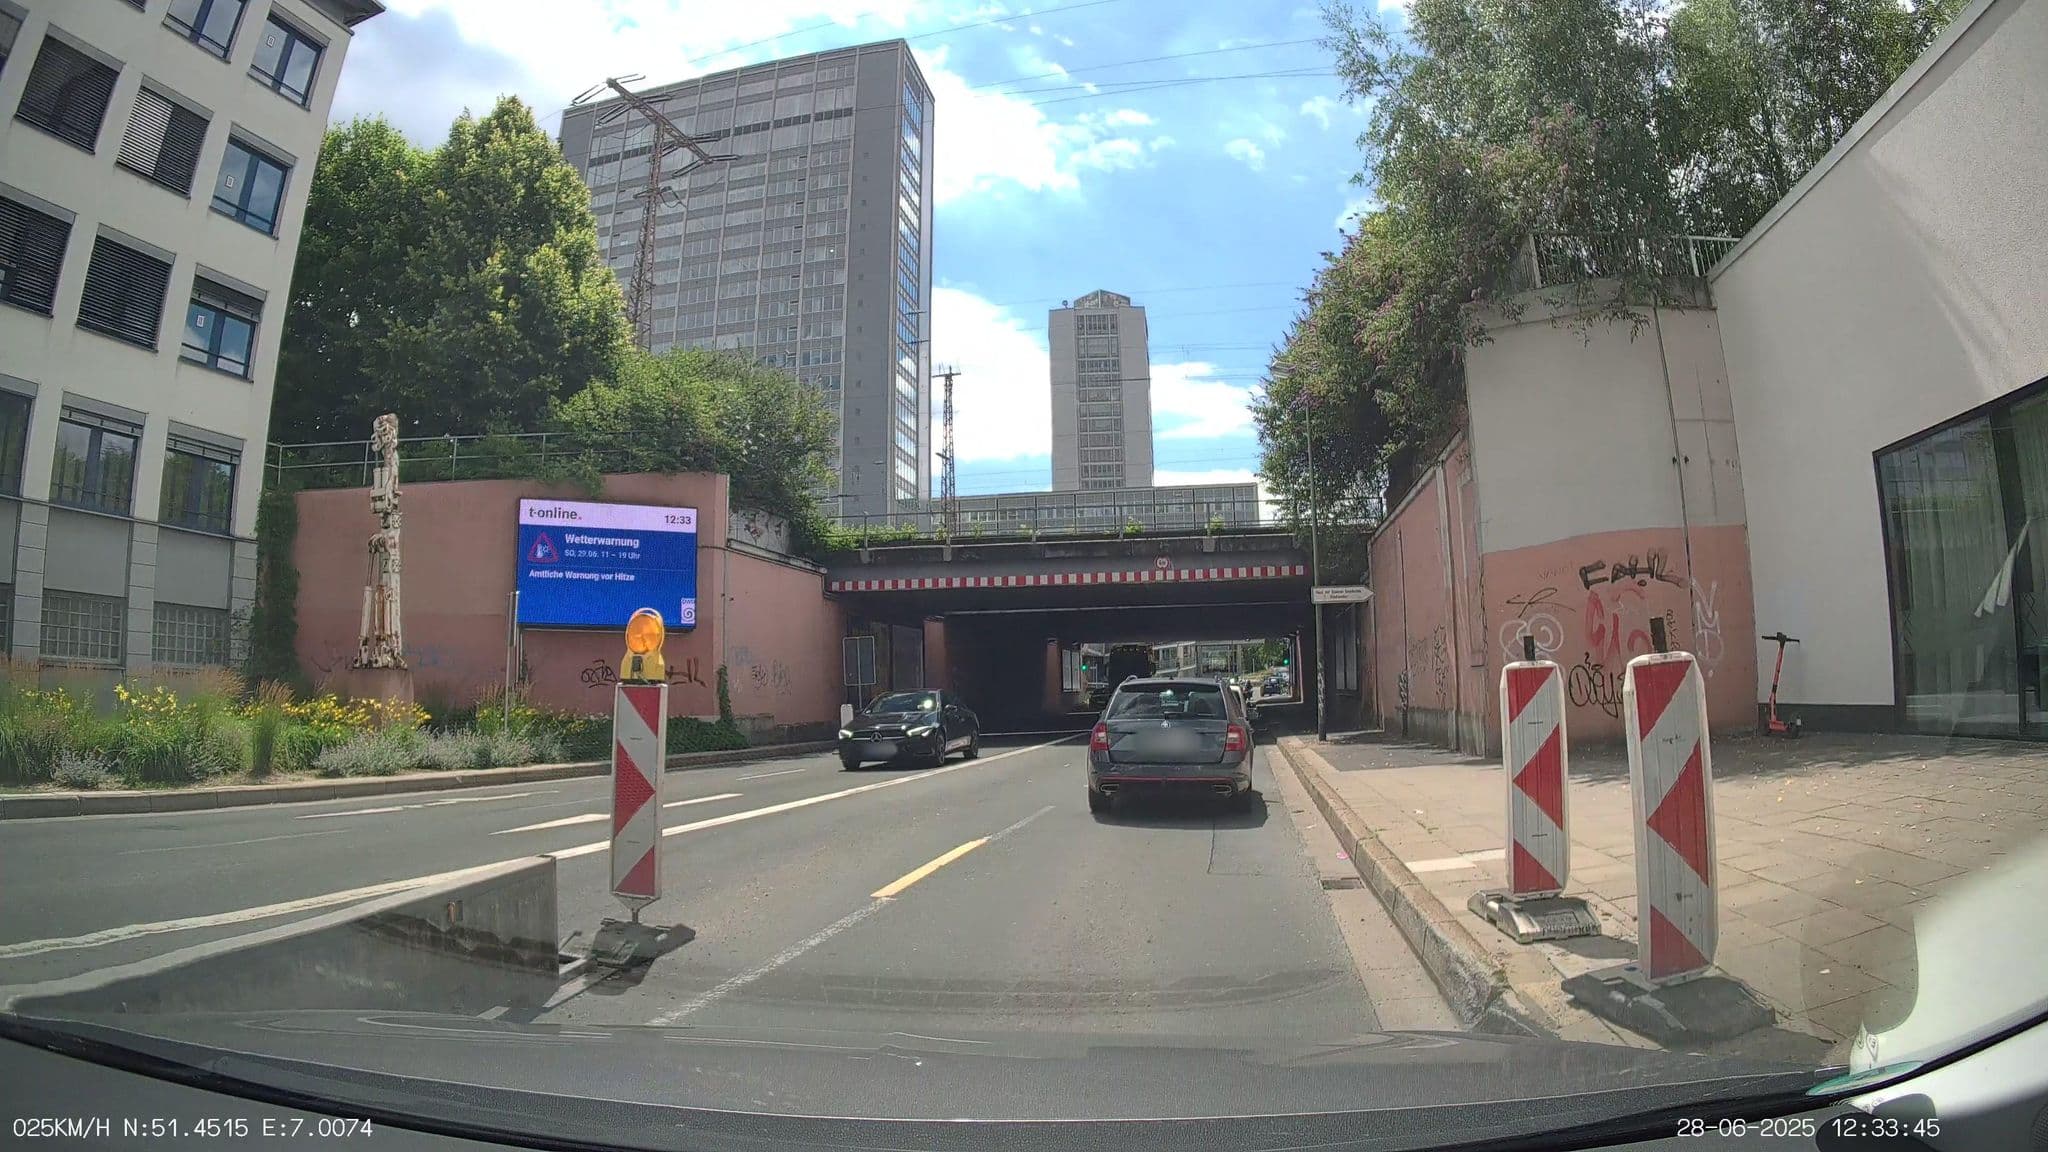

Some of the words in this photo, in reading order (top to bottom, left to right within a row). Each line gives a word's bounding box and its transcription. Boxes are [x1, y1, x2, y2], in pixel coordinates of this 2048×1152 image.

[664, 514, 692, 525] 12:33
[565, 533, 640, 549] Wetterwarnung
[628, 552, 641, 560] Uhr
[529, 569, 563, 579] Amtliche
[565, 571, 600, 581] Warnung
[614, 572, 635, 581] Hitze
